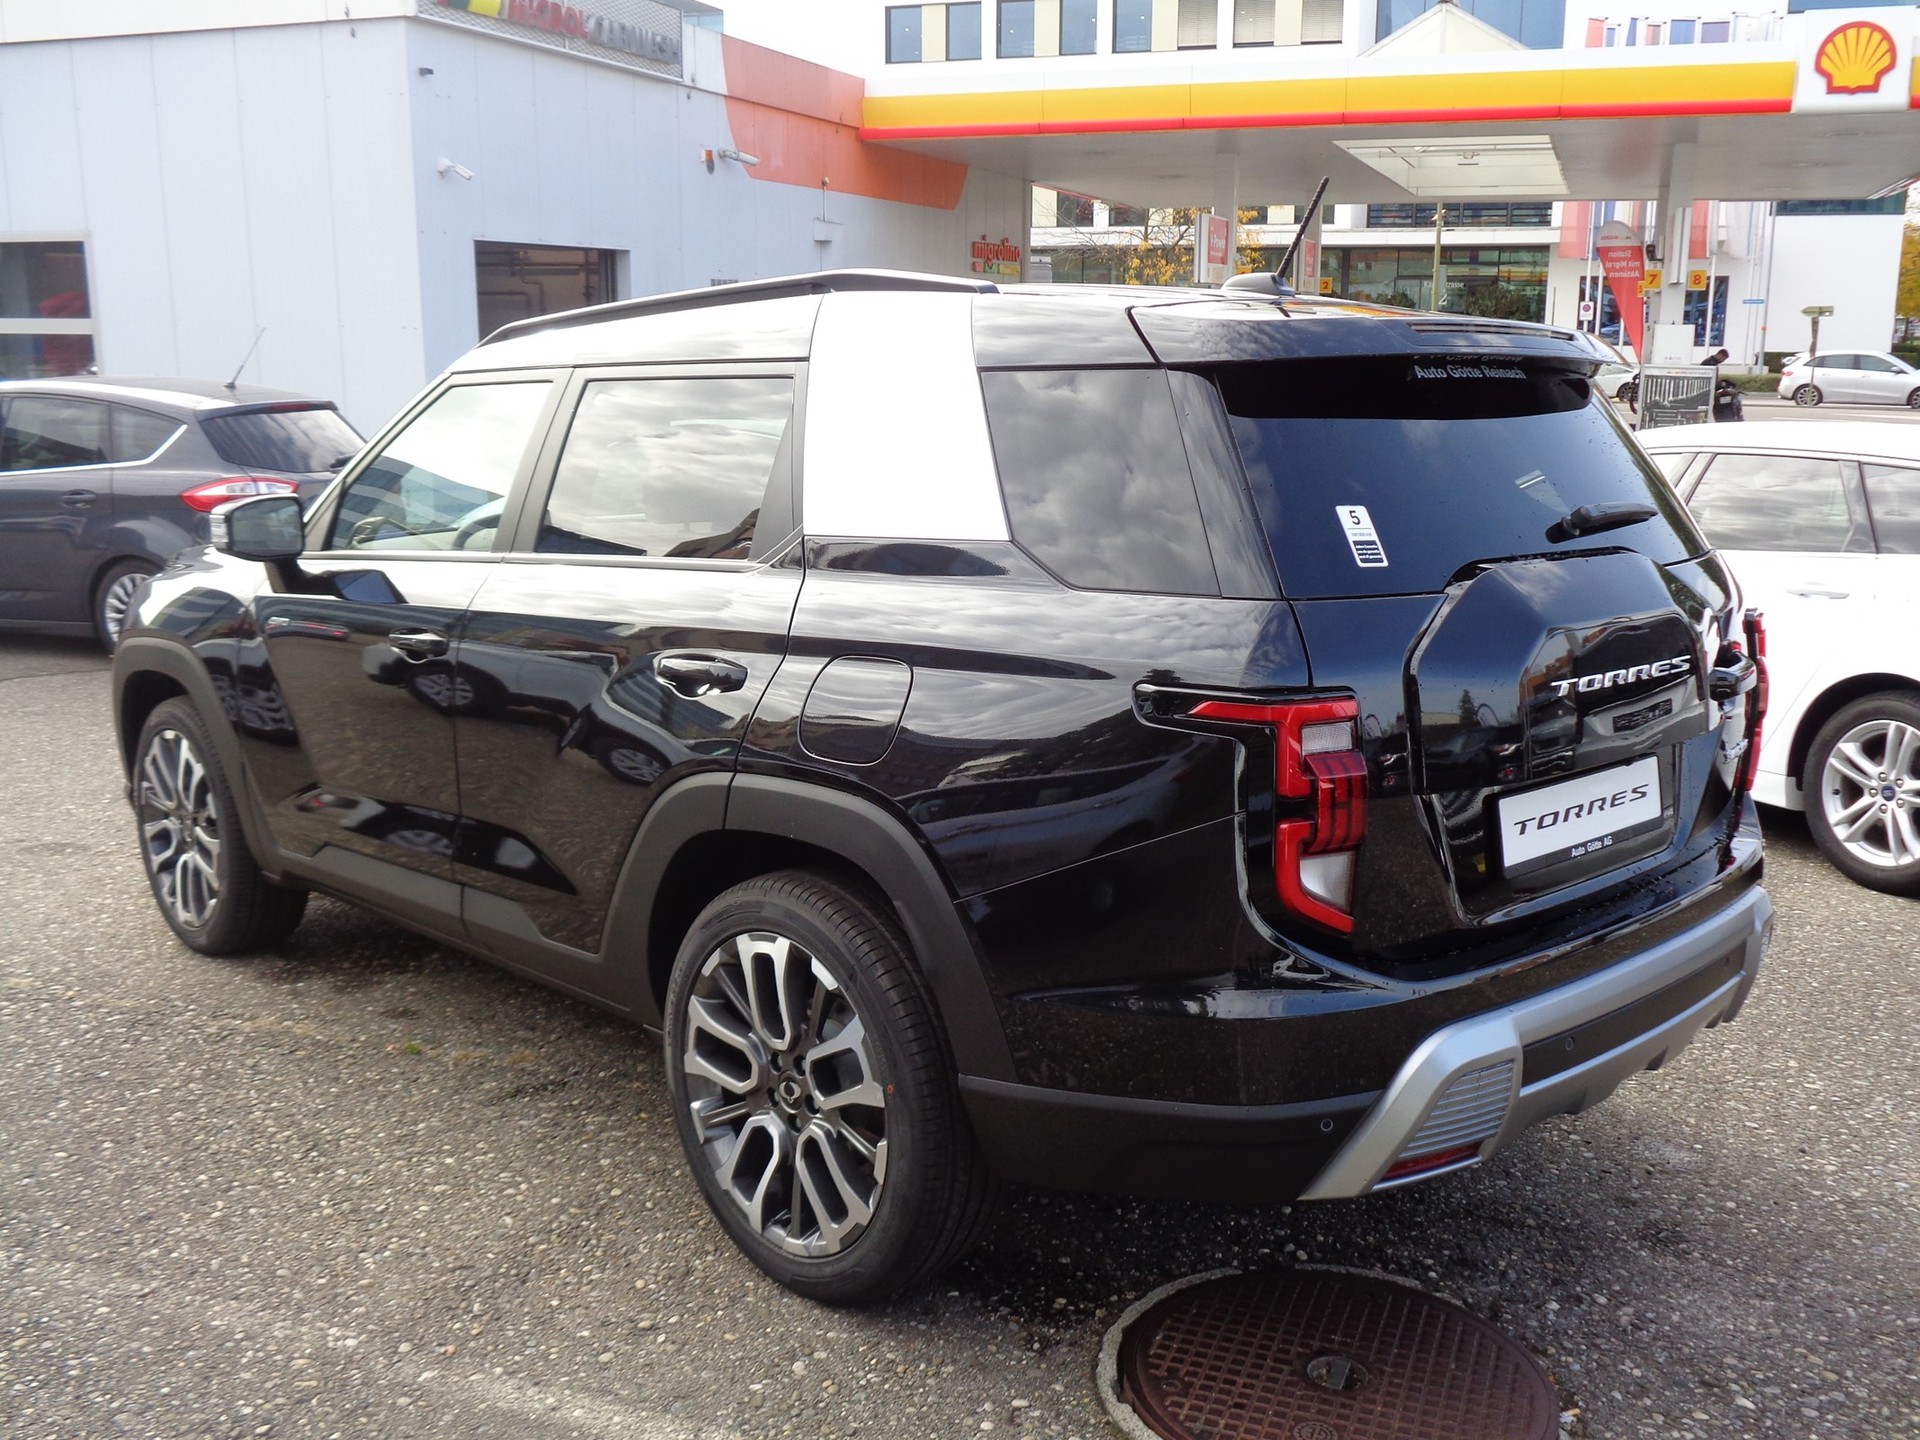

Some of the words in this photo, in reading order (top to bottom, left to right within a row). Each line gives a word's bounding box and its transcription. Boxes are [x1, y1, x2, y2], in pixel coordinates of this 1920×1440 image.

[971, 234, 1021, 269] migrolino
[1322, 281, 1330, 290] 2
[1648, 274, 1659, 285] 7
[1692, 273, 1702, 285] 8
[1414, 365, 1447, 379] Auto
[1446, 364, 1483, 379] Götte
[1480, 364, 1527, 379] Reinach
[1348, 510, 1361, 525] 5
[1550, 655, 1692, 697] TORRES
[1514, 783, 1649, 836] TORRES
[1571, 846, 1586, 858] Auto
[1603, 835, 1613, 847] AG
